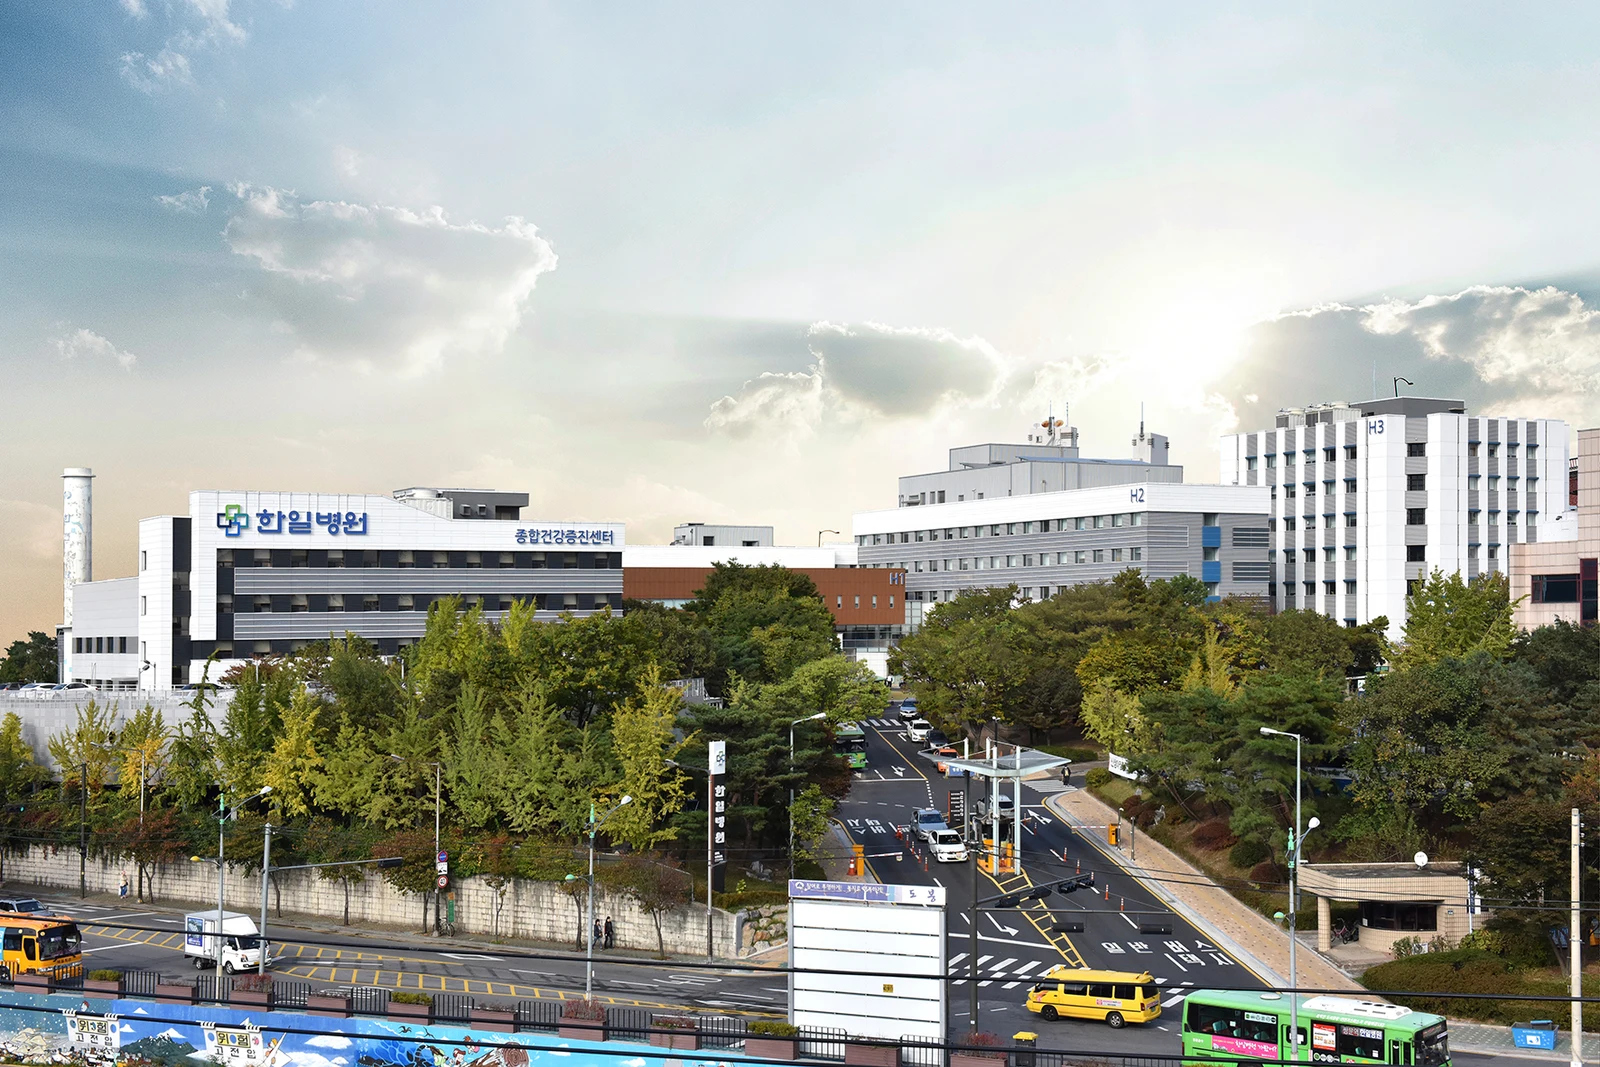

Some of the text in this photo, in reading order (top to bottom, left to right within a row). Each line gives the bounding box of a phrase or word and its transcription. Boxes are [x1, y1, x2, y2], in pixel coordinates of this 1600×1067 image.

[1369, 420, 1384, 435] H3
[1130, 488, 1145, 503] H2
[256, 509, 367, 536] 한일병원
[515, 529, 614, 545] 종합건강증진센터
[889, 572, 904, 585] H1
[715, 785, 725, 844] 한일병원
[79, 1020, 107, 1034] 위험
[75, 1032, 113, 1047] 고전압
[218, 1032, 249, 1046] 위험
[214, 1045, 257, 1060] 고전압
